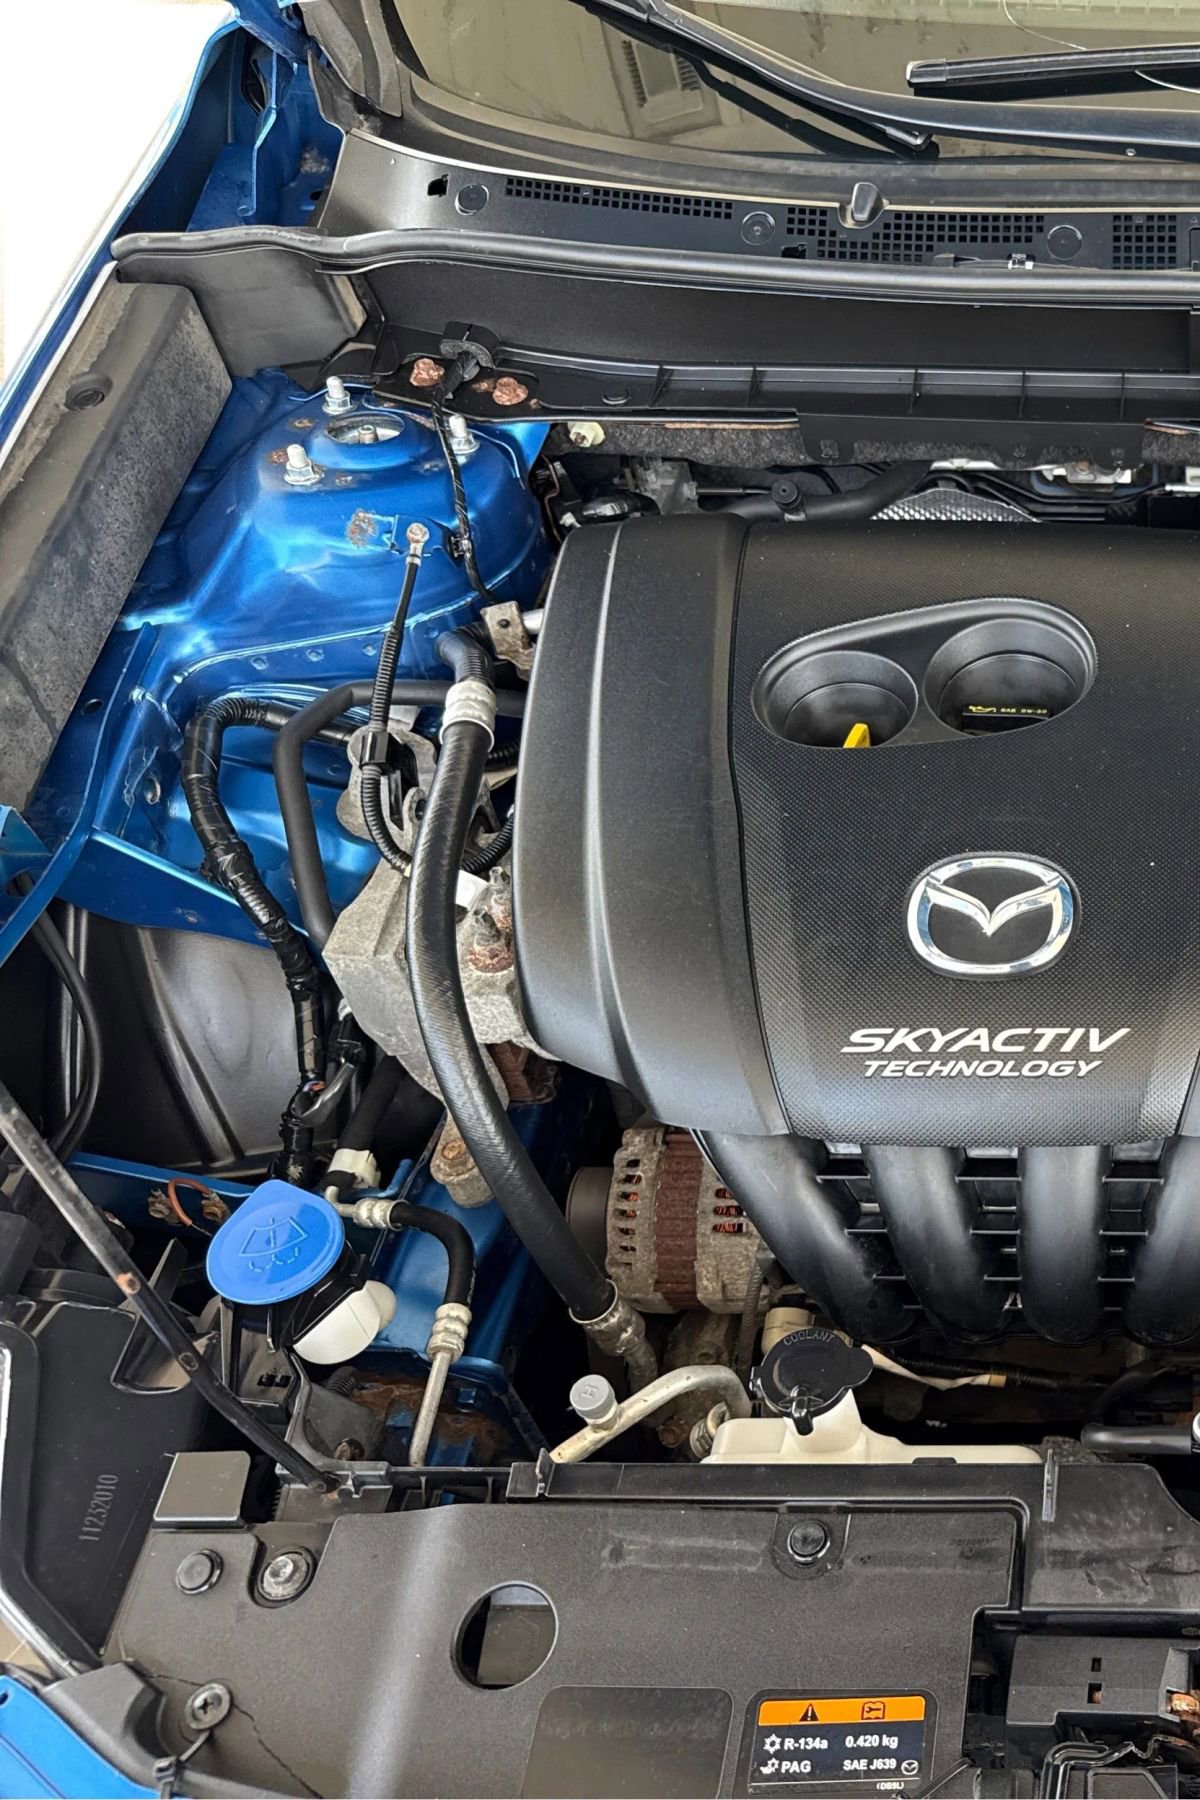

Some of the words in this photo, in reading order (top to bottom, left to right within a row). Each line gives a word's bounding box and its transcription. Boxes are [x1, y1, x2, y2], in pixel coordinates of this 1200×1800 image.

[840, 1027, 1131, 1053] SKYACTIV
[863, 1060, 1103, 1078] TECHNOLOGY
[783, 1330, 836, 1346] COOLANT
[78, 1474, 119, 1541] 11232010
[784, 1737, 829, 1750] R-134a
[845, 1735, 880, 1748] 0.420
[882, 1734, 898, 1749] kg
[781, 1760, 812, 1773] PAG
[842, 1759, 867, 1771] SAE
[869, 1757, 897, 1770] J639
